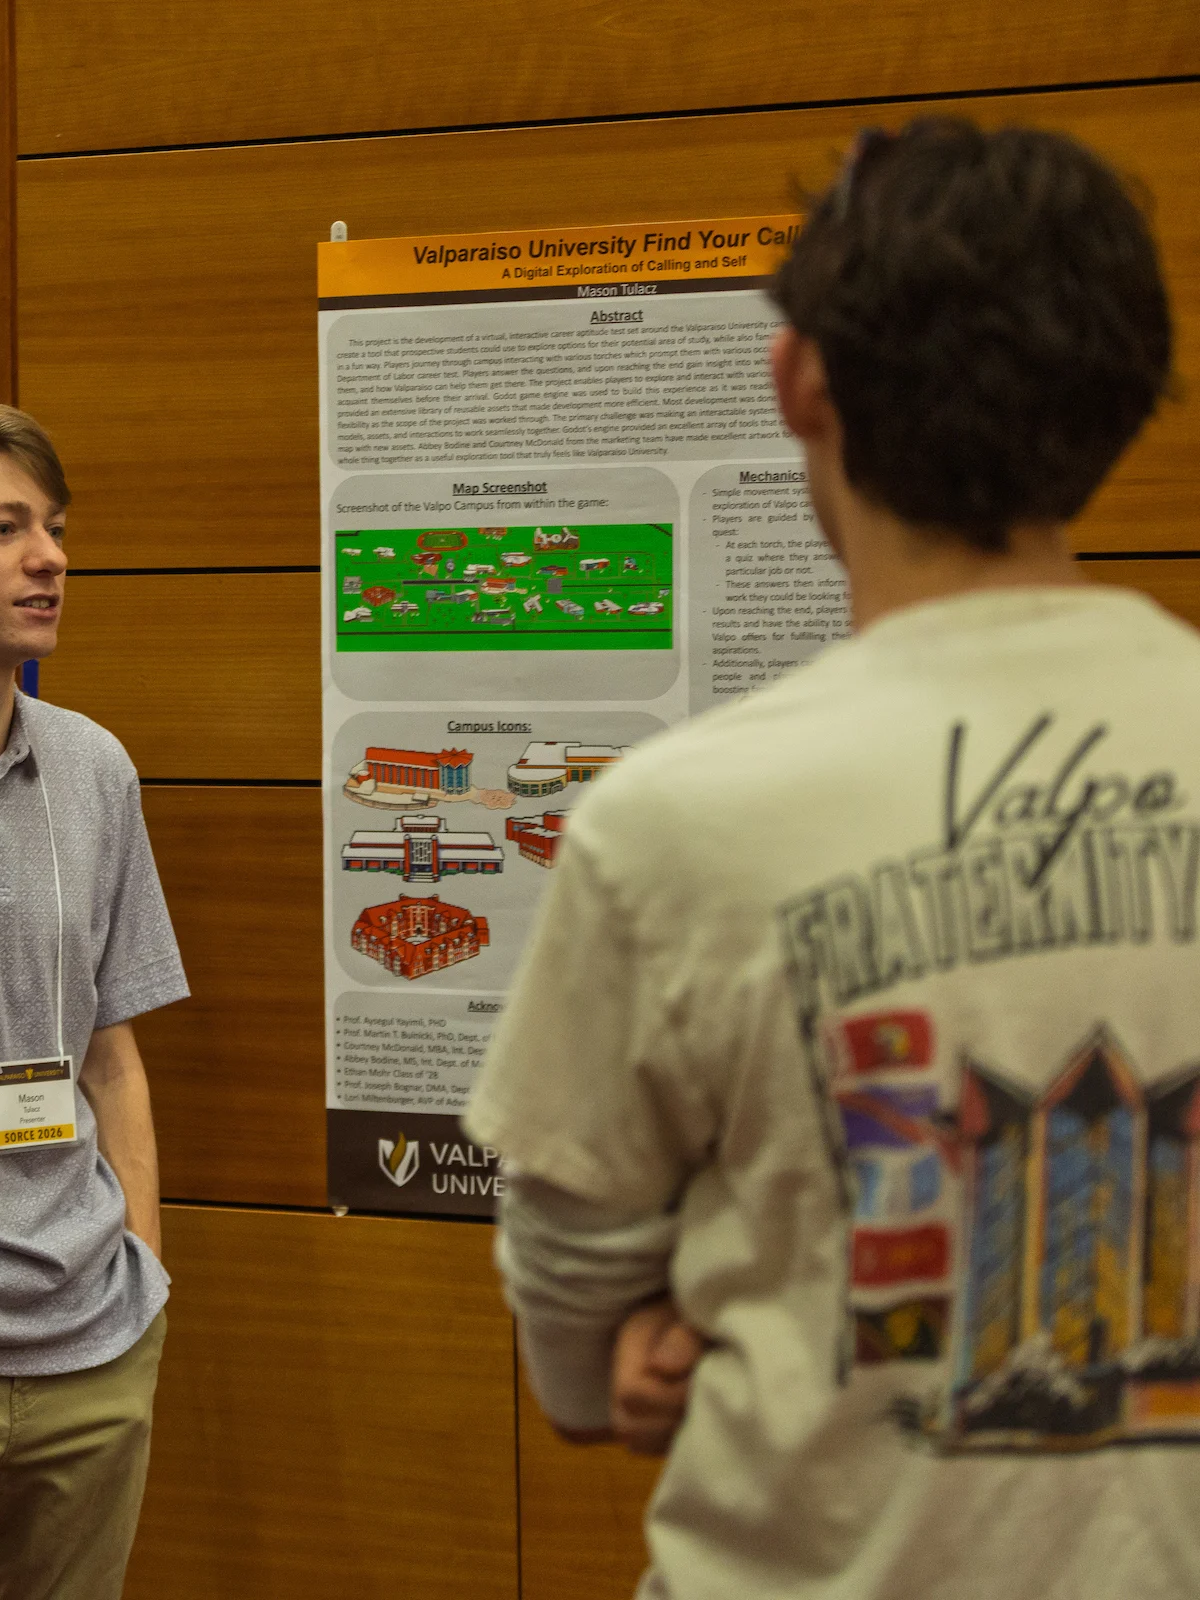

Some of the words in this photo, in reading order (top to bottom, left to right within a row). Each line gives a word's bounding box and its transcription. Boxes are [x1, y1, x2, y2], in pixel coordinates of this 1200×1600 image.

[413, 243, 522, 268] Valparaiso
[528, 235, 637, 260] University
[643, 232, 691, 253] Find
[698, 230, 750, 249] Your
[501, 268, 511, 279] A
[514, 264, 553, 280] Digital
[556, 261, 627, 279] Exploration
[631, 260, 644, 272] of
[647, 257, 691, 275] Calling
[694, 257, 718, 269] and
[721, 255, 747, 267] Self
[577, 285, 618, 297] Mason
[620, 283, 658, 296] Tulacz
[590, 309, 644, 323] Abstract
[349, 337, 363, 346] This
[365, 336, 390, 348] project
[393, 336, 398, 344] is
[400, 335, 412, 344] the
[414, 333, 464, 346] development
[465, 333, 473, 341] of
[481, 331, 507, 343] virtual,
[509, 329, 548, 340] interactive
[576, 327, 608, 339] aptitude
[610, 326, 625, 335] test
[627, 326, 638, 335] set
[640, 324, 668, 334] around
[670, 324, 683, 333] the
[686, 322, 726, 335] Valparaiso
[728, 320, 767, 333] University
[337, 455, 359, 464] whole
[360, 454, 379, 466] thing
[380, 453, 412, 465] together
[431, 452, 454, 461] useful
[455, 451, 497, 463] exploration
[499, 450, 514, 459] tool
[516, 450, 531, 459] that
[533, 449, 550, 461] truly
[552, 449, 570, 458] feels
[572, 448, 584, 457] like
[587, 447, 626, 459] Valparaiso
[628, 446, 668, 458] University.
[739, 470, 806, 482] Mechanics
[452, 483, 479, 495] Map
[482, 481, 548, 493] Screenshot
[712, 487, 740, 499] Simple
[743, 486, 788, 496] movement
[336, 503, 389, 514] Screenshot
[391, 502, 402, 512] of
[403, 502, 420, 512] the
[423, 501, 452, 513] Valpo
[454, 501, 495, 512] Campus
[497, 499, 521, 510] from
[523, 498, 555, 509] within
[557, 498, 574, 508] the
[577, 499, 609, 510] game:
[712, 500, 759, 513] exploration
[762, 500, 770, 509] of
[774, 500, 797, 511] Valpo
[712, 514, 744, 526] Players
[767, 513, 798, 525] guided
[803, 512, 814, 524] by
[725, 540, 734, 549] At
[737, 540, 756, 549] each
[760, 540, 785, 551] torch,
[787, 539, 802, 548] the
[735, 553, 752, 565] quiz
[758, 553, 784, 561] where
[789, 552, 809, 564] they
[725, 566, 765, 578] particular
[768, 566, 782, 578] job
[795, 566, 813, 574] not.
[726, 579, 750, 588] These
[793, 578, 813, 587] then
[725, 592, 746, 601] work
[748, 592, 767, 604] they
[770, 592, 793, 600] could
[795, 592, 806, 600] be
[808, 592, 840, 603] looking
[712, 606, 735, 617] Upon
[738, 605, 774, 617] reaching
[777, 605, 791, 614] the
[794, 605, 813, 617] end,
[712, 619, 740, 627] results
[743, 619, 759, 627] and
[762, 619, 782, 627] have
[785, 618, 799, 627] the
[803, 618, 829, 630] ability
[832, 618, 842, 627] to
[712, 632, 737, 644] Valpo
[741, 632, 768, 640] offers
[772, 631, 784, 640] for
[790, 631, 826, 643] fulfilling
[712, 658, 765, 670] Additionally,
[767, 658, 797, 670] players
[712, 672, 744, 683] people
[749, 672, 765, 680] and
[447, 720, 494, 733] Campus
[497, 719, 532, 732] Icons:
[940, 708, 1177, 888] Valpo
[776, 818, 1200, 1006] FRATERNITY
[18, 1093, 45, 1103] Mason
[19, 1115, 46, 1125] Presenter
[4, 1130, 35, 1143] SORCE
[38, 1127, 63, 1140] 2026
